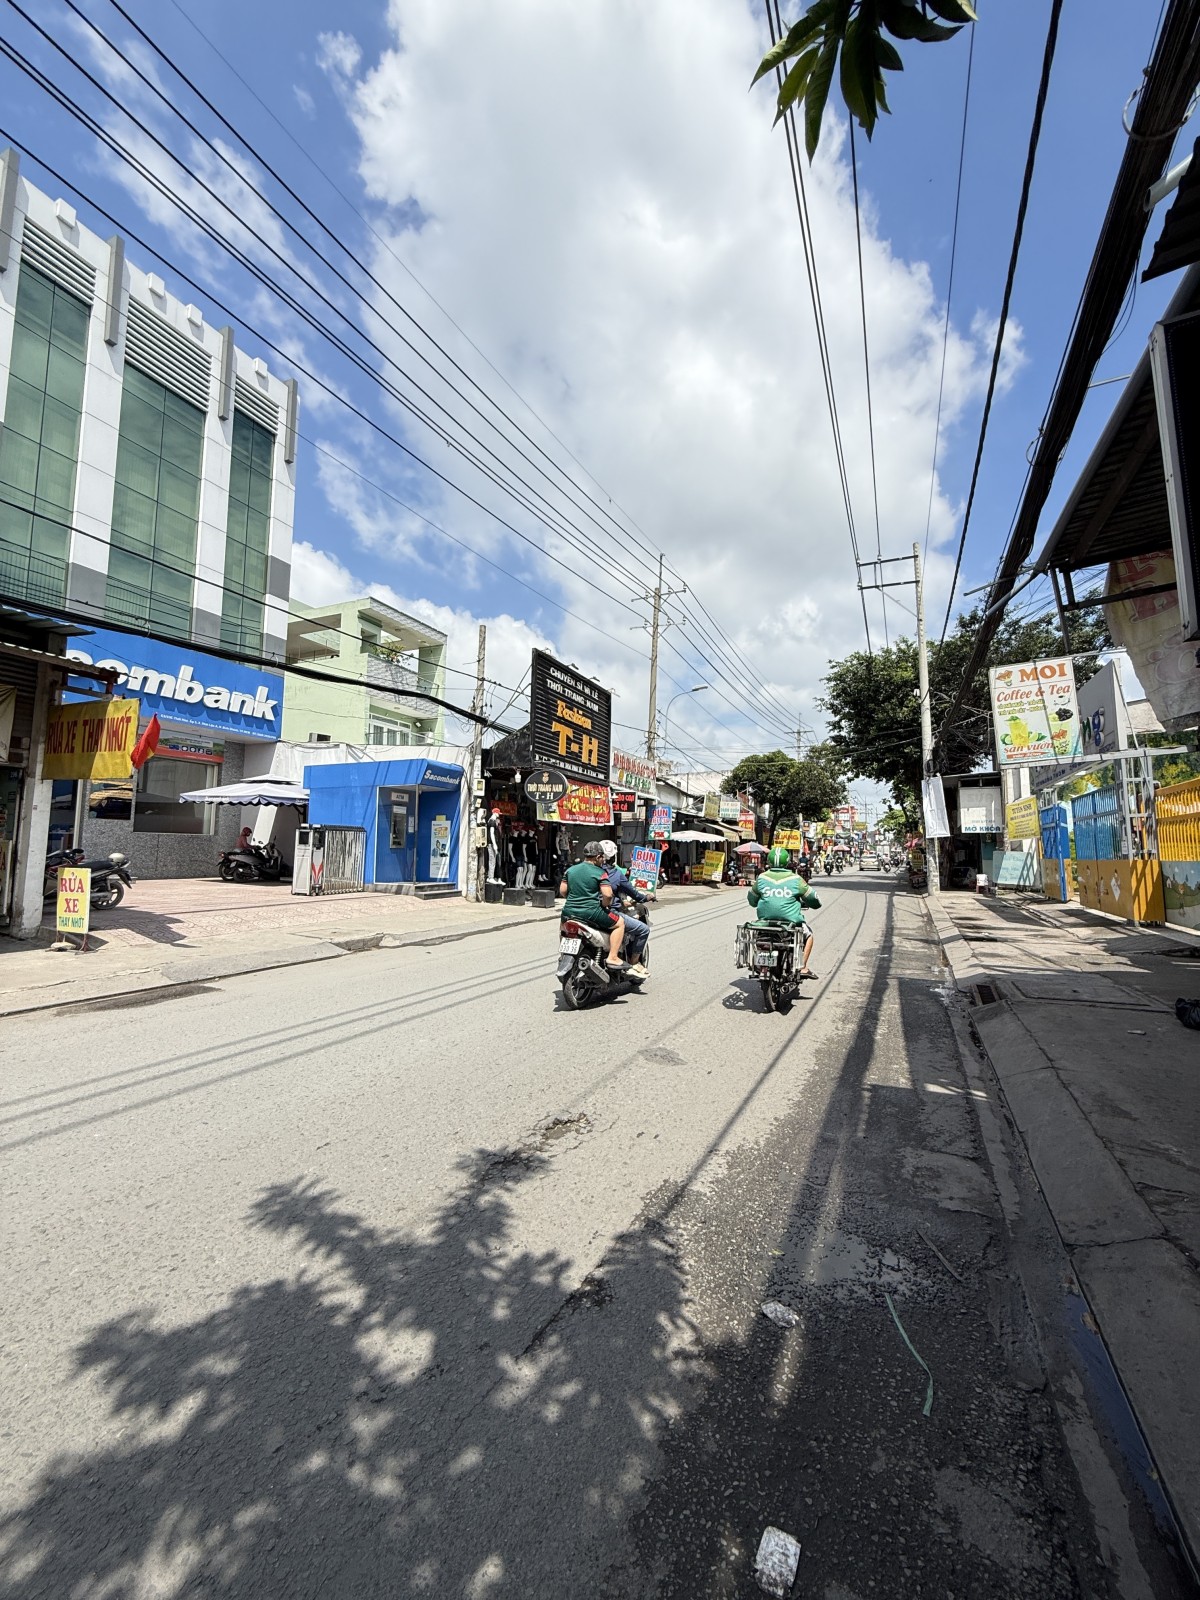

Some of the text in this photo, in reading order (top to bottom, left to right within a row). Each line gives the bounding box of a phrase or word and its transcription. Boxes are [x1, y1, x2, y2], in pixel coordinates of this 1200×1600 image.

[550, 667, 575, 687] CHUYÊN
[1018, 663, 1067, 682] MOI
[565, 688, 584, 706] TRANG
[586, 701, 599, 712] NAM
[996, 684, 1071, 702] Coffee & Tea
[557, 699, 592, 730] Fashion
[64, 719, 78, 754] XE
[82, 718, 106, 753] THAY
[424, 769, 460, 785] Sacombank
[538, 783, 552, 792] TRANG
[552, 783, 563, 793] NAM
[763, 886, 793, 898] Grab
[64, 898, 79, 913] XE
[59, 916, 71, 927] THAY
